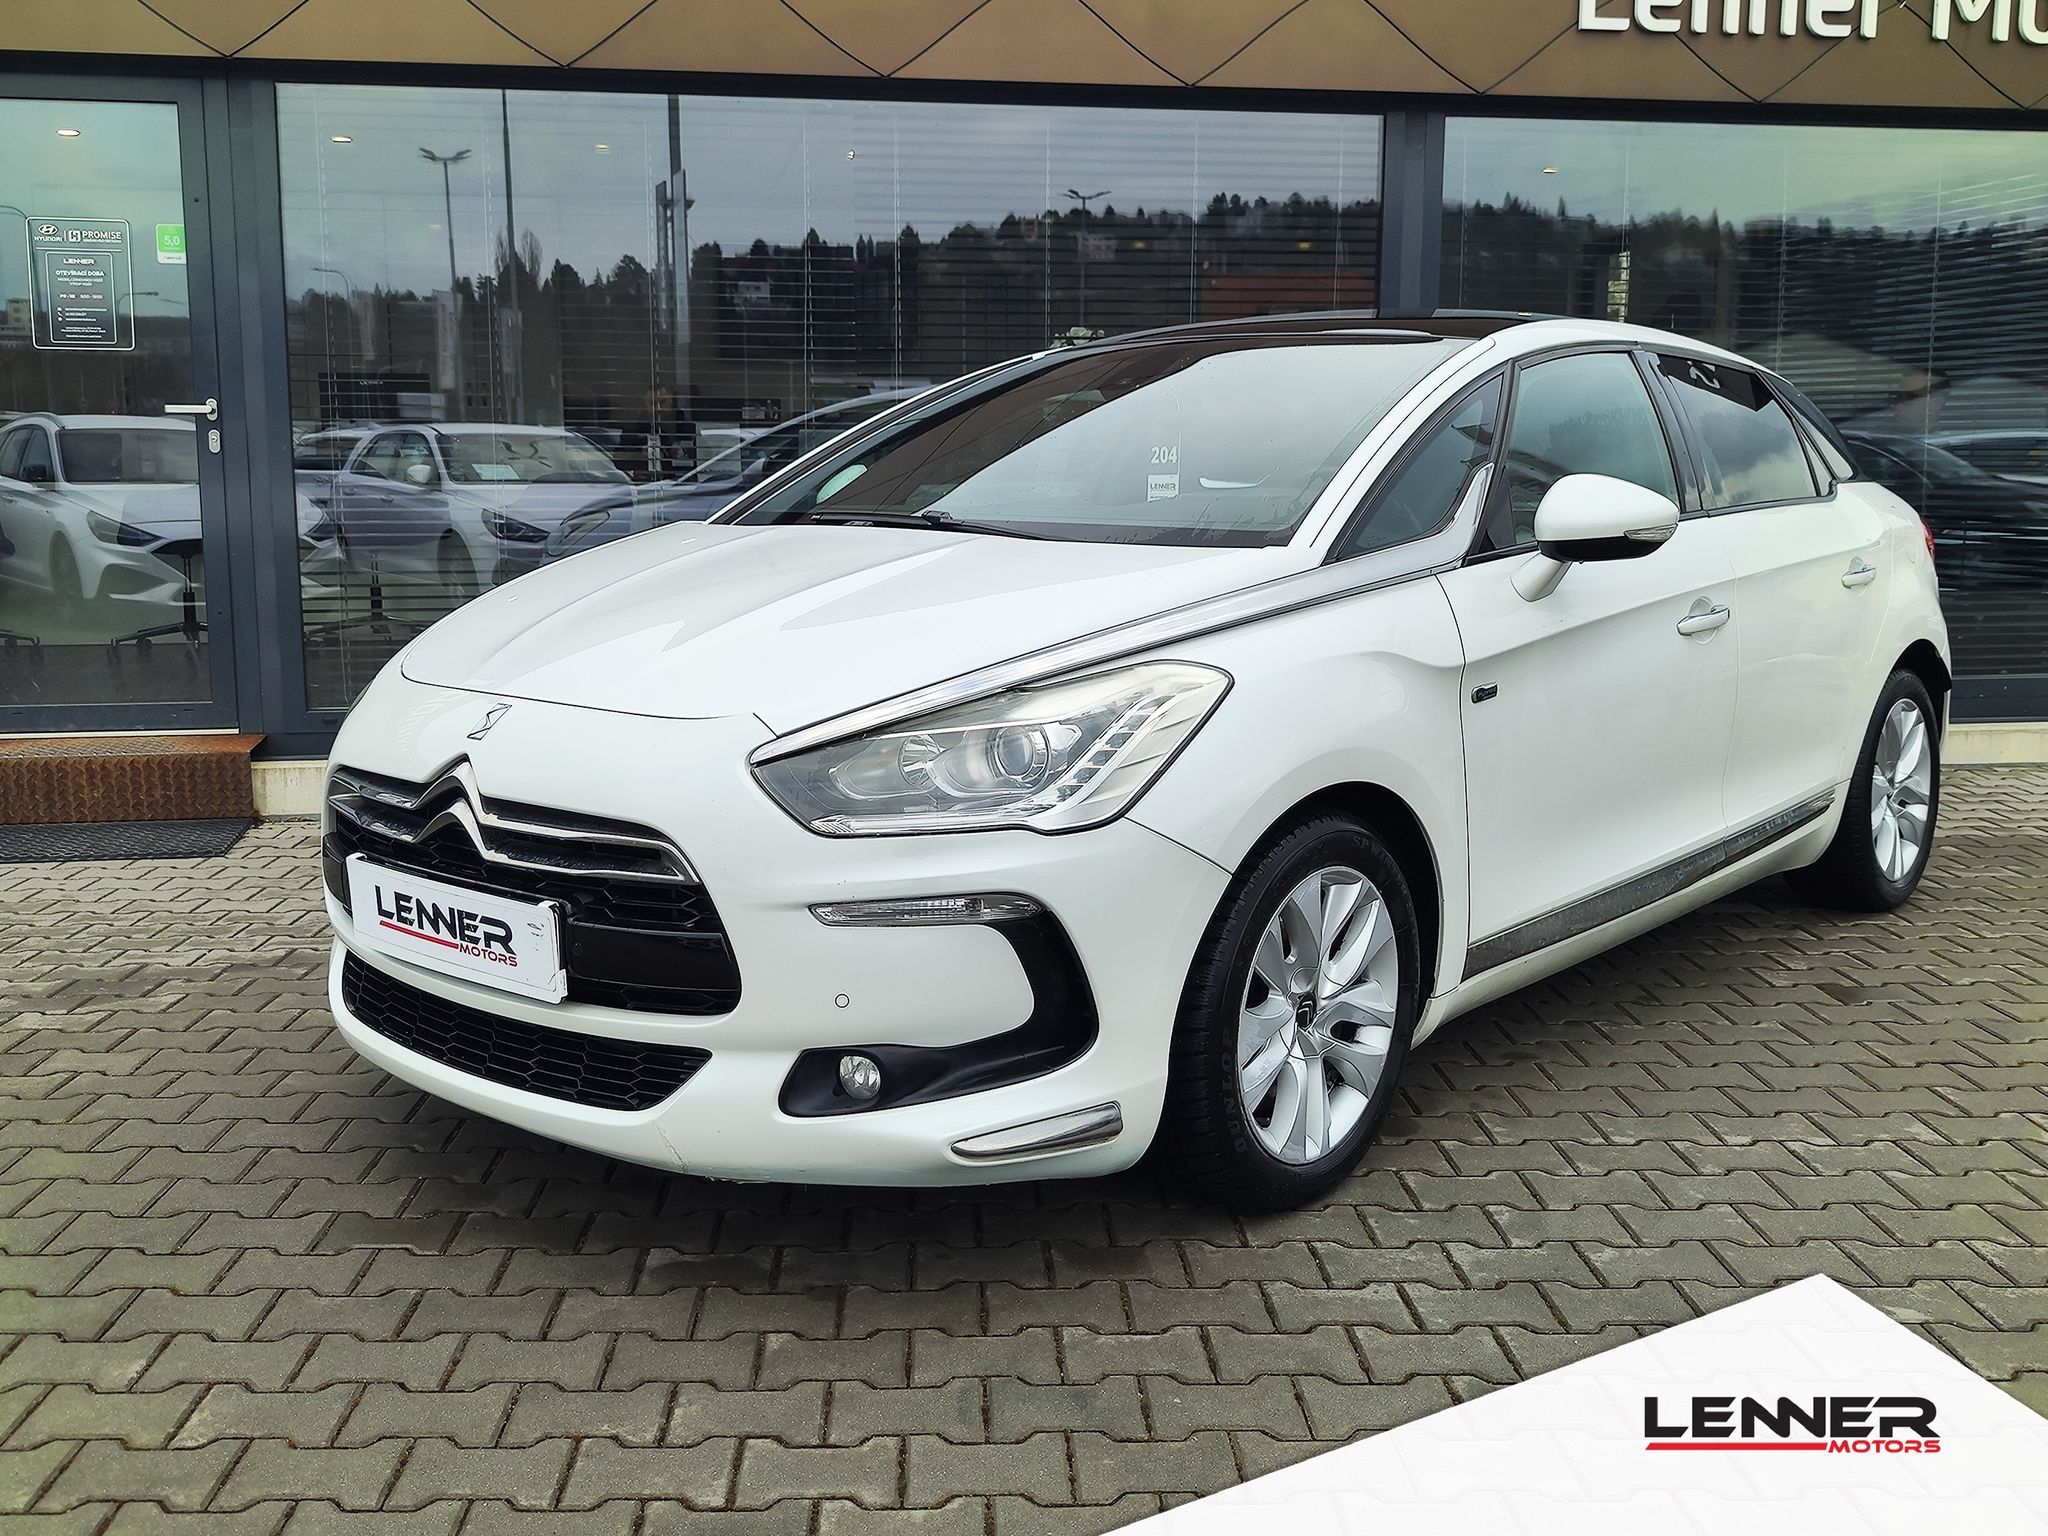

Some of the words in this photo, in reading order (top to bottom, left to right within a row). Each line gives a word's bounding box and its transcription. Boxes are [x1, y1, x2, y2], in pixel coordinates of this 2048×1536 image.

[82, 230, 122, 239] PROMISE
[63, 257, 95, 265] LENNER
[1150, 446, 1178, 464] 204
[374, 885, 517, 955] LENNER
[459, 943, 518, 967] MOTORS
[1221, 1026, 1248, 1153] DUNLOP
